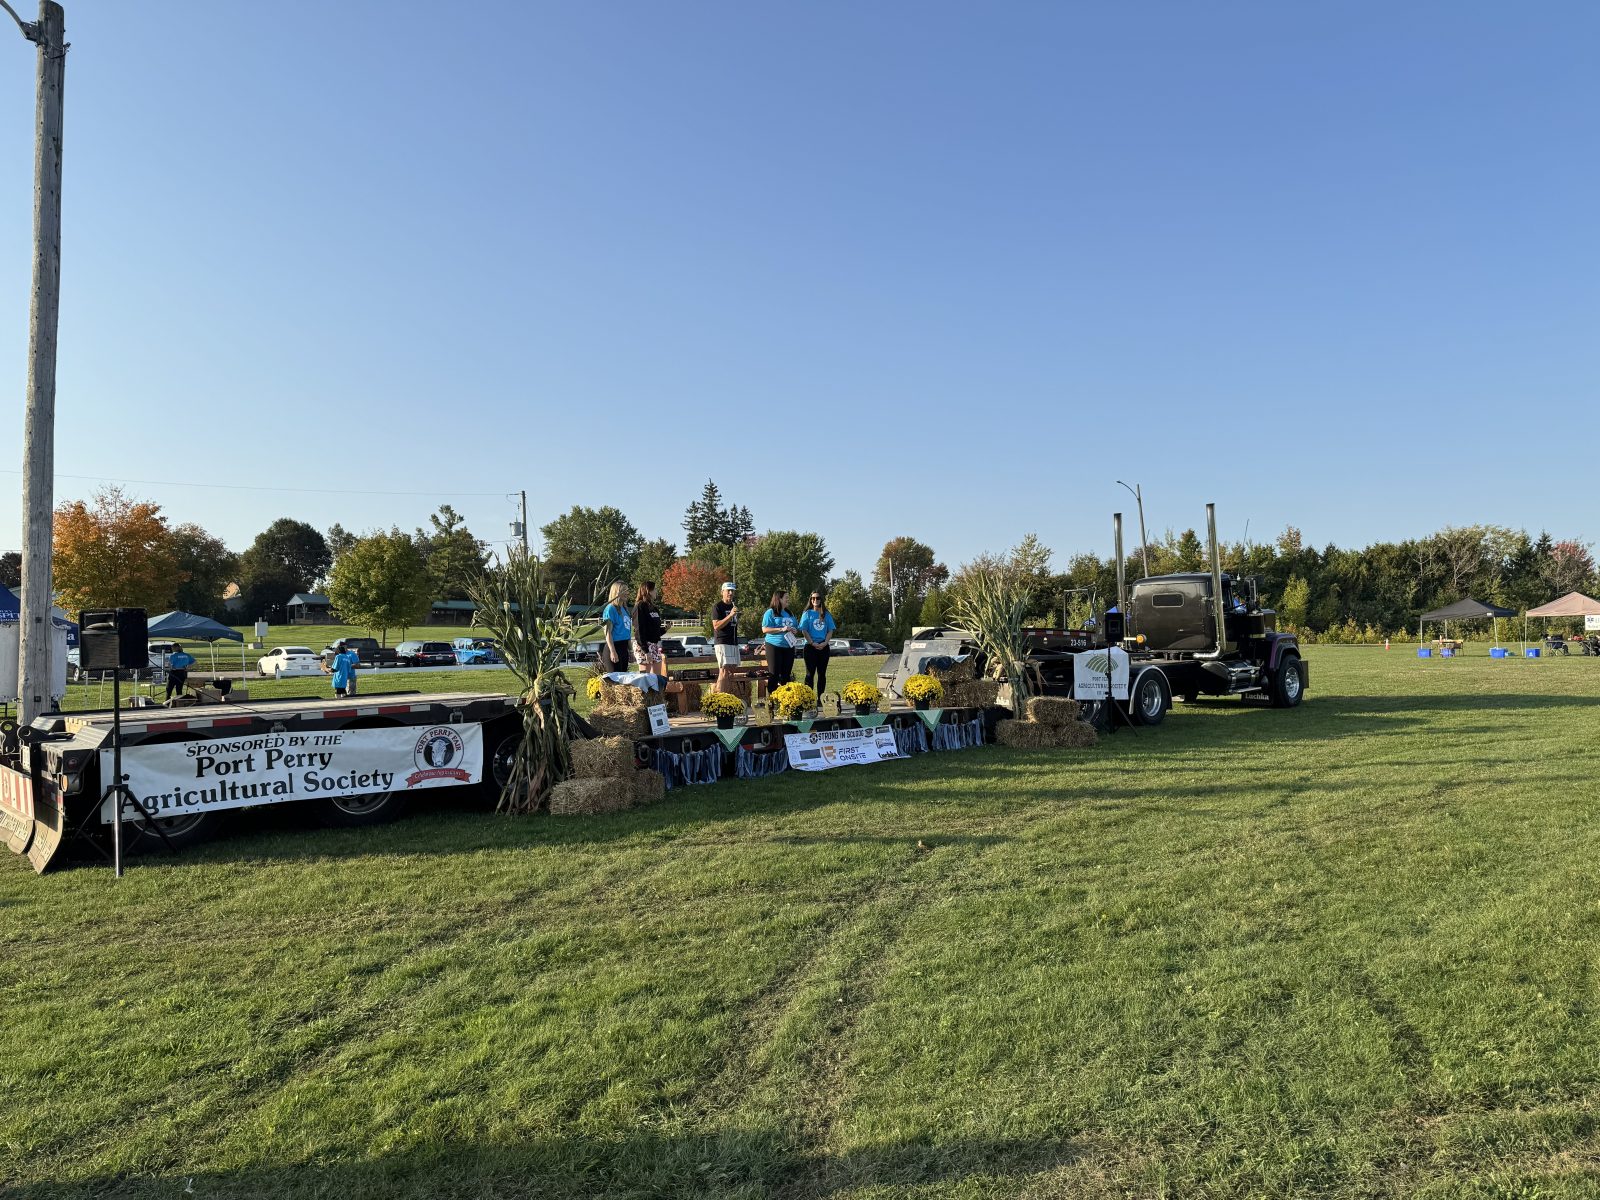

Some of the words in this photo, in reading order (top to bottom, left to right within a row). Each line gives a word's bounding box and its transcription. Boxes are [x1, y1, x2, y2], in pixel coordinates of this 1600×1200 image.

[186, 737, 285, 758] SPONSORED
[288, 735, 310, 747] BY
[313, 734, 342, 746] THE
[417, 735, 429, 754] PORT
[429, 729, 453, 738] PERRY
[451, 735, 462, 752] FAIR
[818, 731, 839, 740] STRONG
[840, 731, 846, 739] IN
[839, 746, 860, 755] FIRST
[840, 752, 867, 761] ONSITE
[195, 753, 256, 778] Port
[265, 749, 334, 770] Perry
[122, 772, 294, 816] Agricultural
[303, 769, 394, 792] Society
